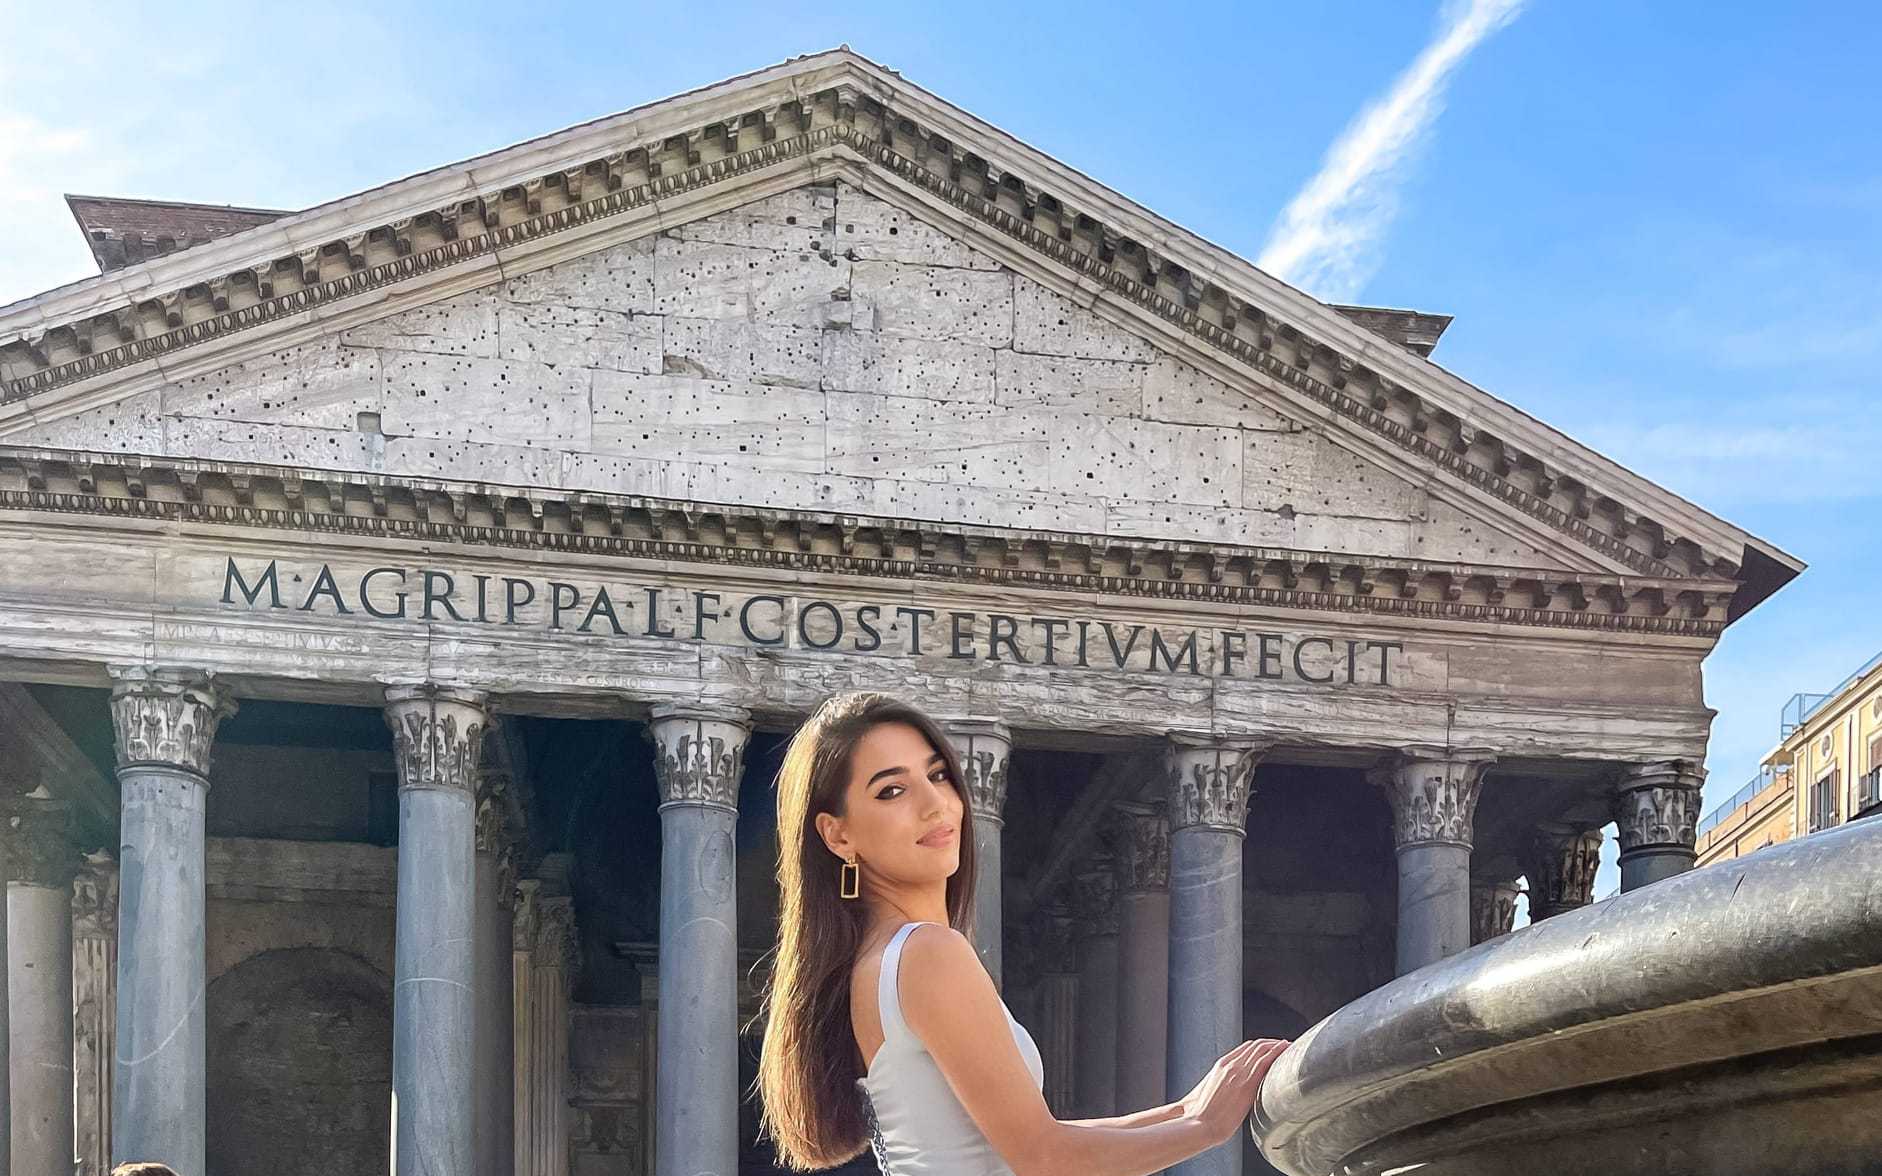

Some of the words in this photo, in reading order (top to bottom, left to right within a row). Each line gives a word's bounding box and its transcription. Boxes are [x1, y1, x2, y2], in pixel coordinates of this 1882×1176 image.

[219, 555, 289, 609] M
[295, 563, 629, 638] AGRIPPA
[641, 587, 677, 639] L
[691, 591, 722, 641] F
[739, 595, 882, 652] COS
[896, 606, 1201, 675] TERTIVM
[1219, 631, 1405, 688] FECIT
